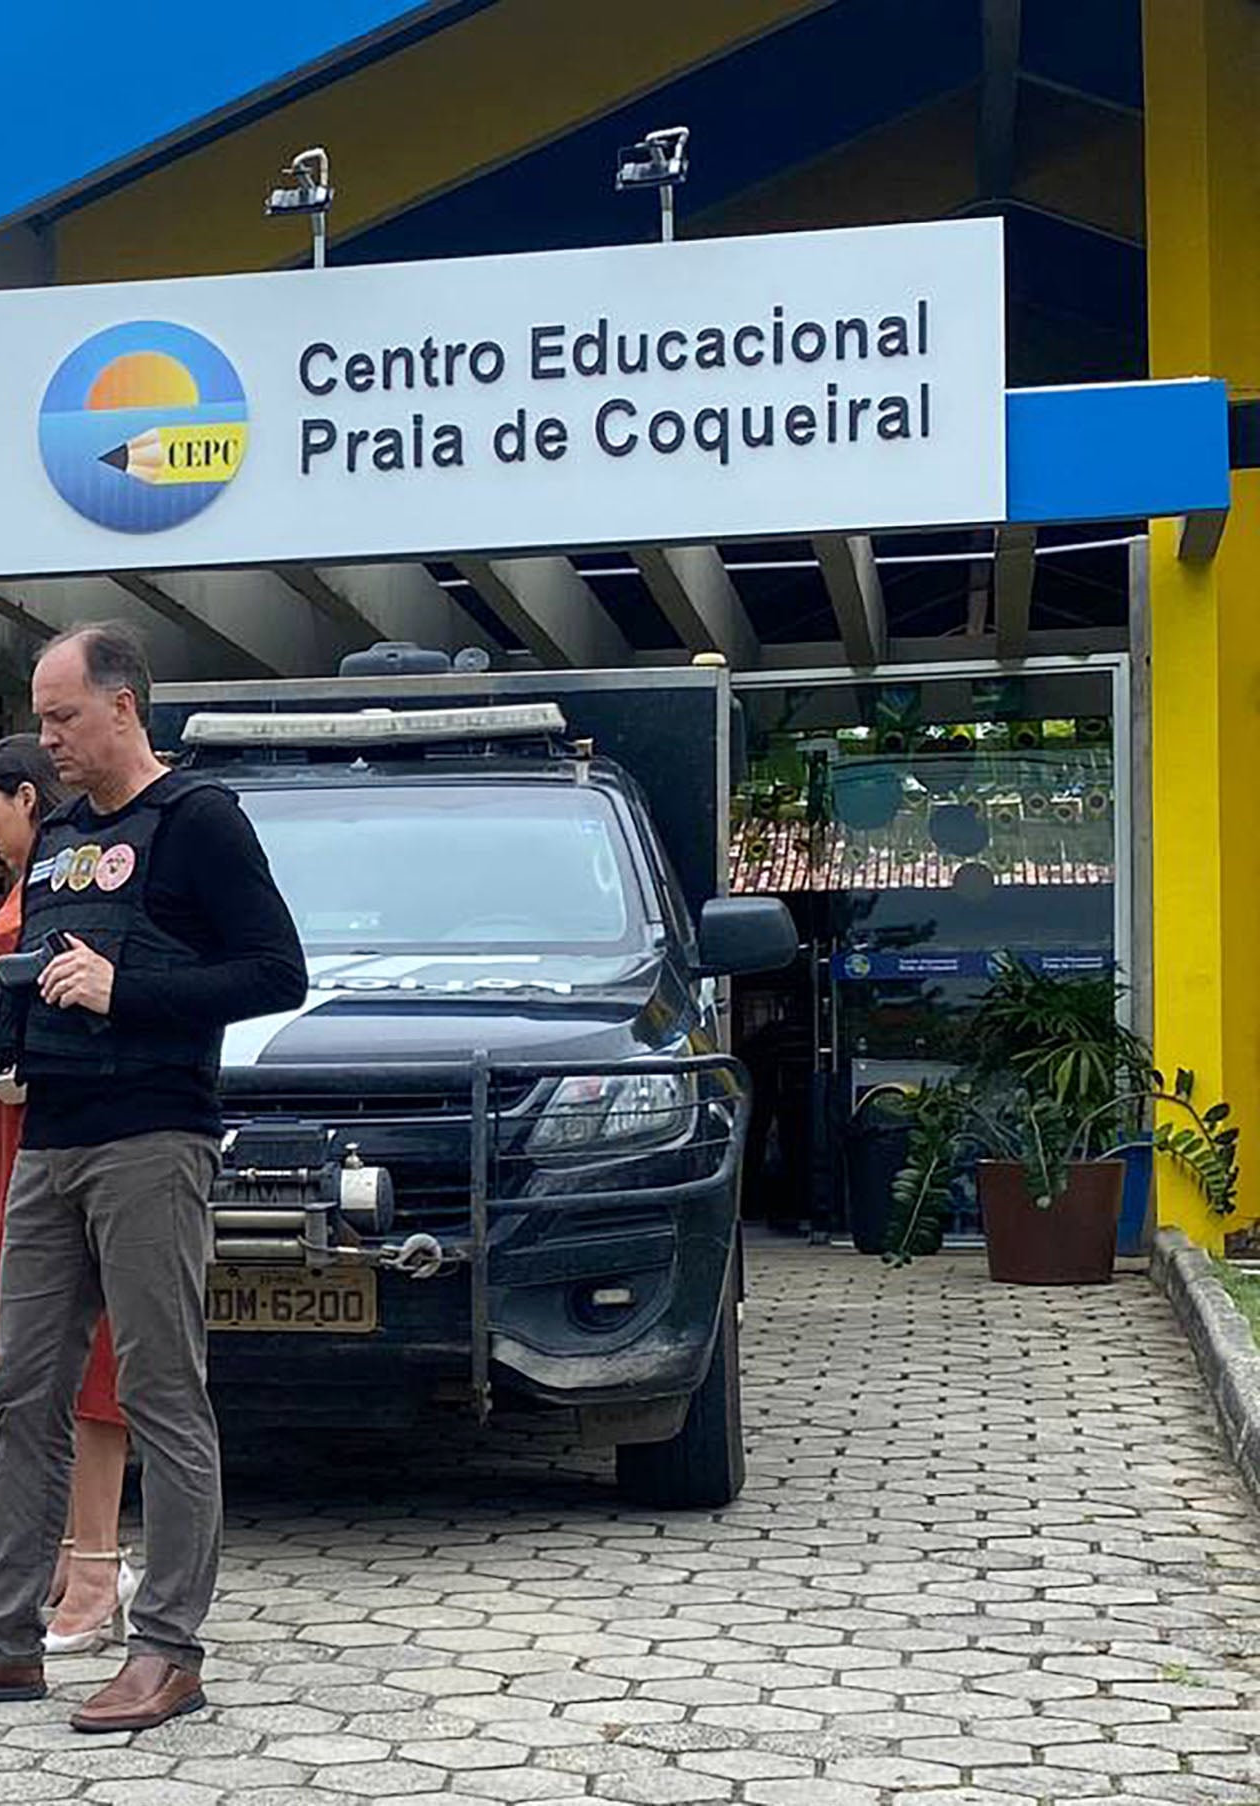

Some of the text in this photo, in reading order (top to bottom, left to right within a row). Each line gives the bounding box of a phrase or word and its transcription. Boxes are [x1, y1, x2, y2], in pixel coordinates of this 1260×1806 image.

[298, 299, 928, 396] Centro Educacional
[168, 438, 239, 470] CEPC
[301, 382, 930, 475] Praia de Coqueiral
